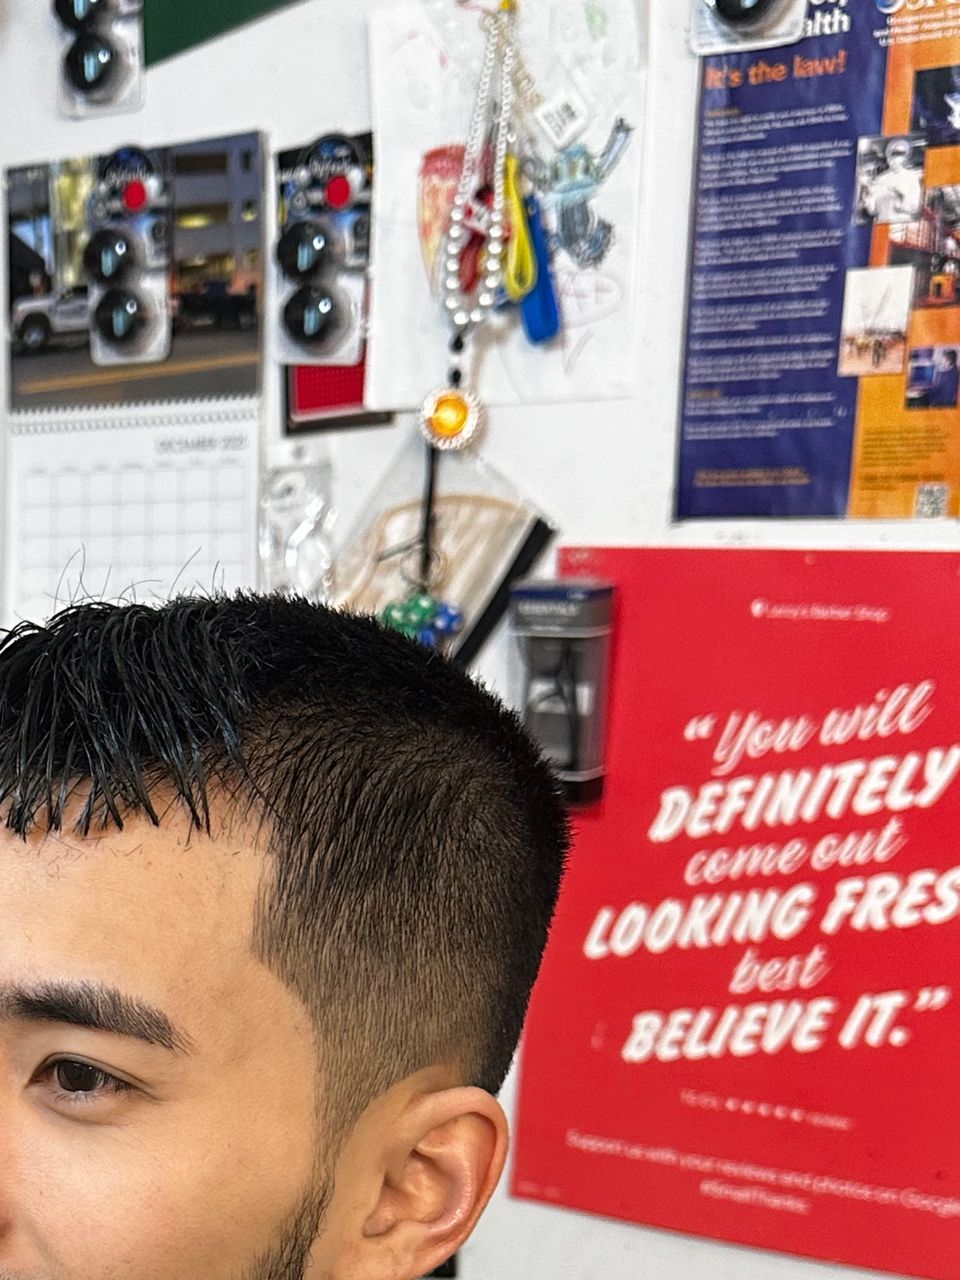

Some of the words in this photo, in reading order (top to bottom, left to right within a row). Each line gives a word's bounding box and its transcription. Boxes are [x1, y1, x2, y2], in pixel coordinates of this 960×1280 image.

[704, 65, 743, 90] It's
[748, 60, 788, 86] the
[793, 49, 848, 78] law!
[819, 681, 935, 747] will
[647, 744, 960, 843] DEFINITELY
[684, 836, 807, 887] come
[810, 815, 909, 873] out
[582, 882, 818, 960] LOOKING
[728, 944, 832, 995] best
[620, 996, 837, 1063] BELIEVE
